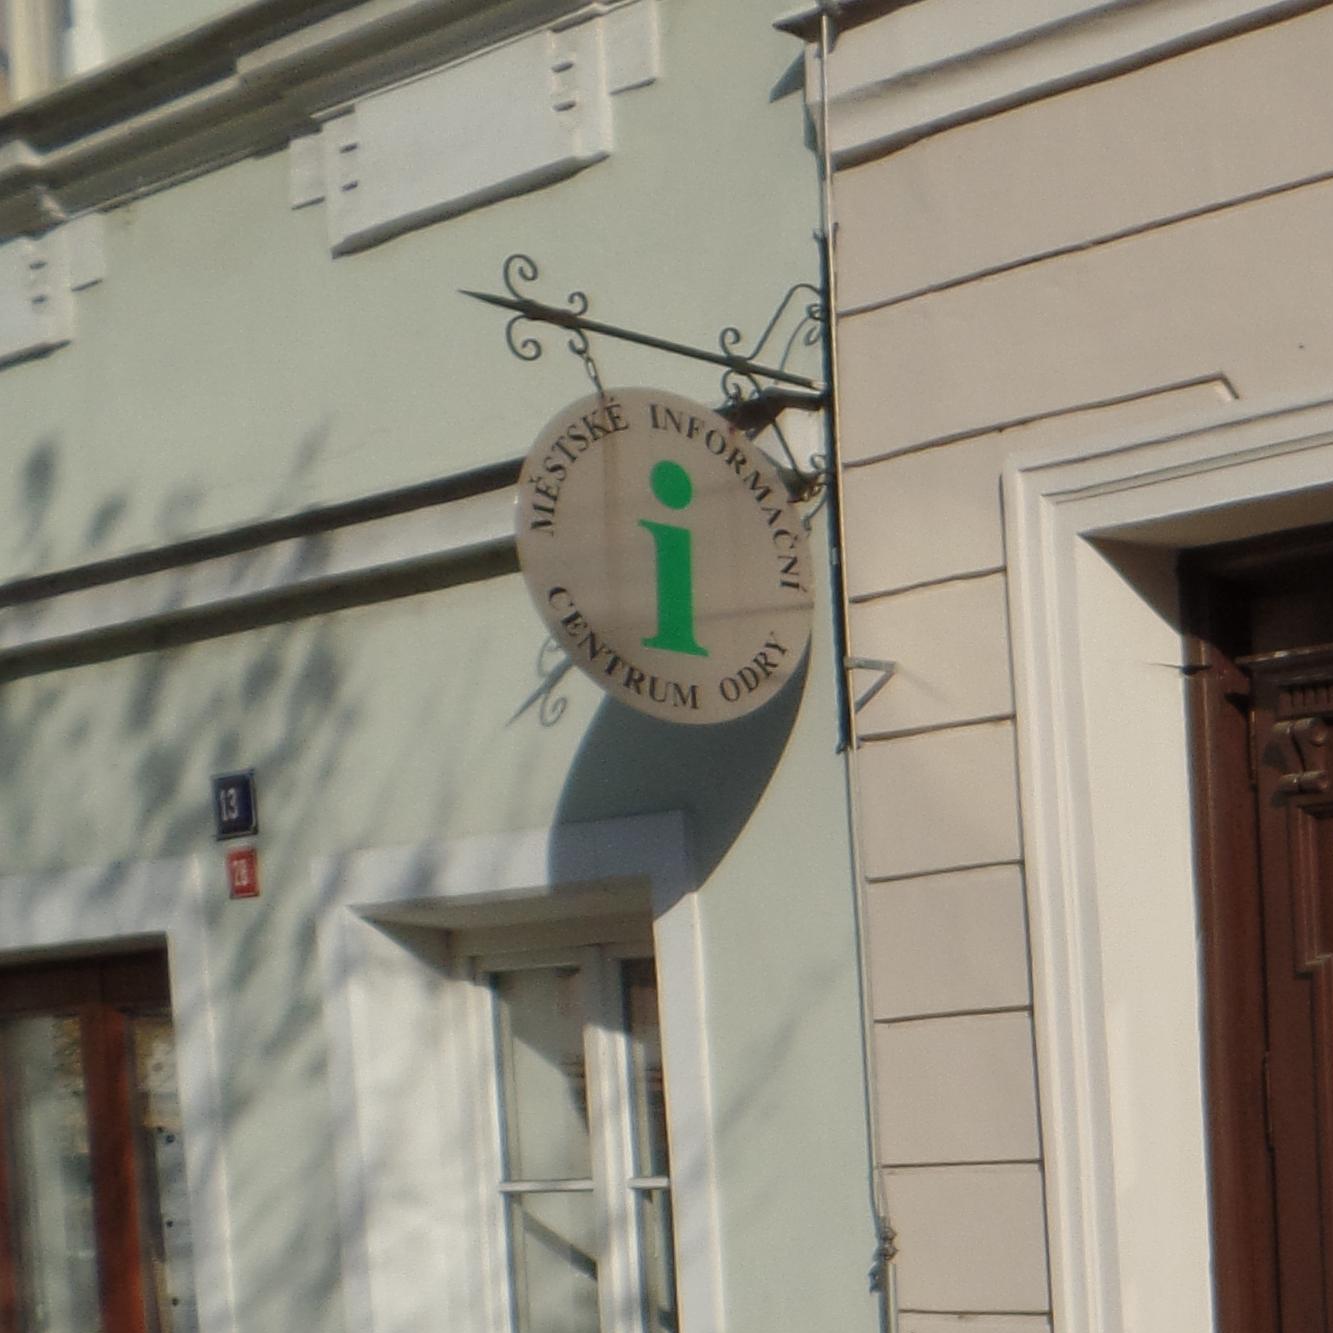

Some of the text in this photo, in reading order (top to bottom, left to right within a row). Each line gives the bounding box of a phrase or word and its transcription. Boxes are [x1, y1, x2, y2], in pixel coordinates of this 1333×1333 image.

[530, 397, 808, 593] MĚSTSKÉ INFORMAČNÍ
[547, 586, 788, 709] CENTRUM ODRY
[220, 787, 239, 821] 13
